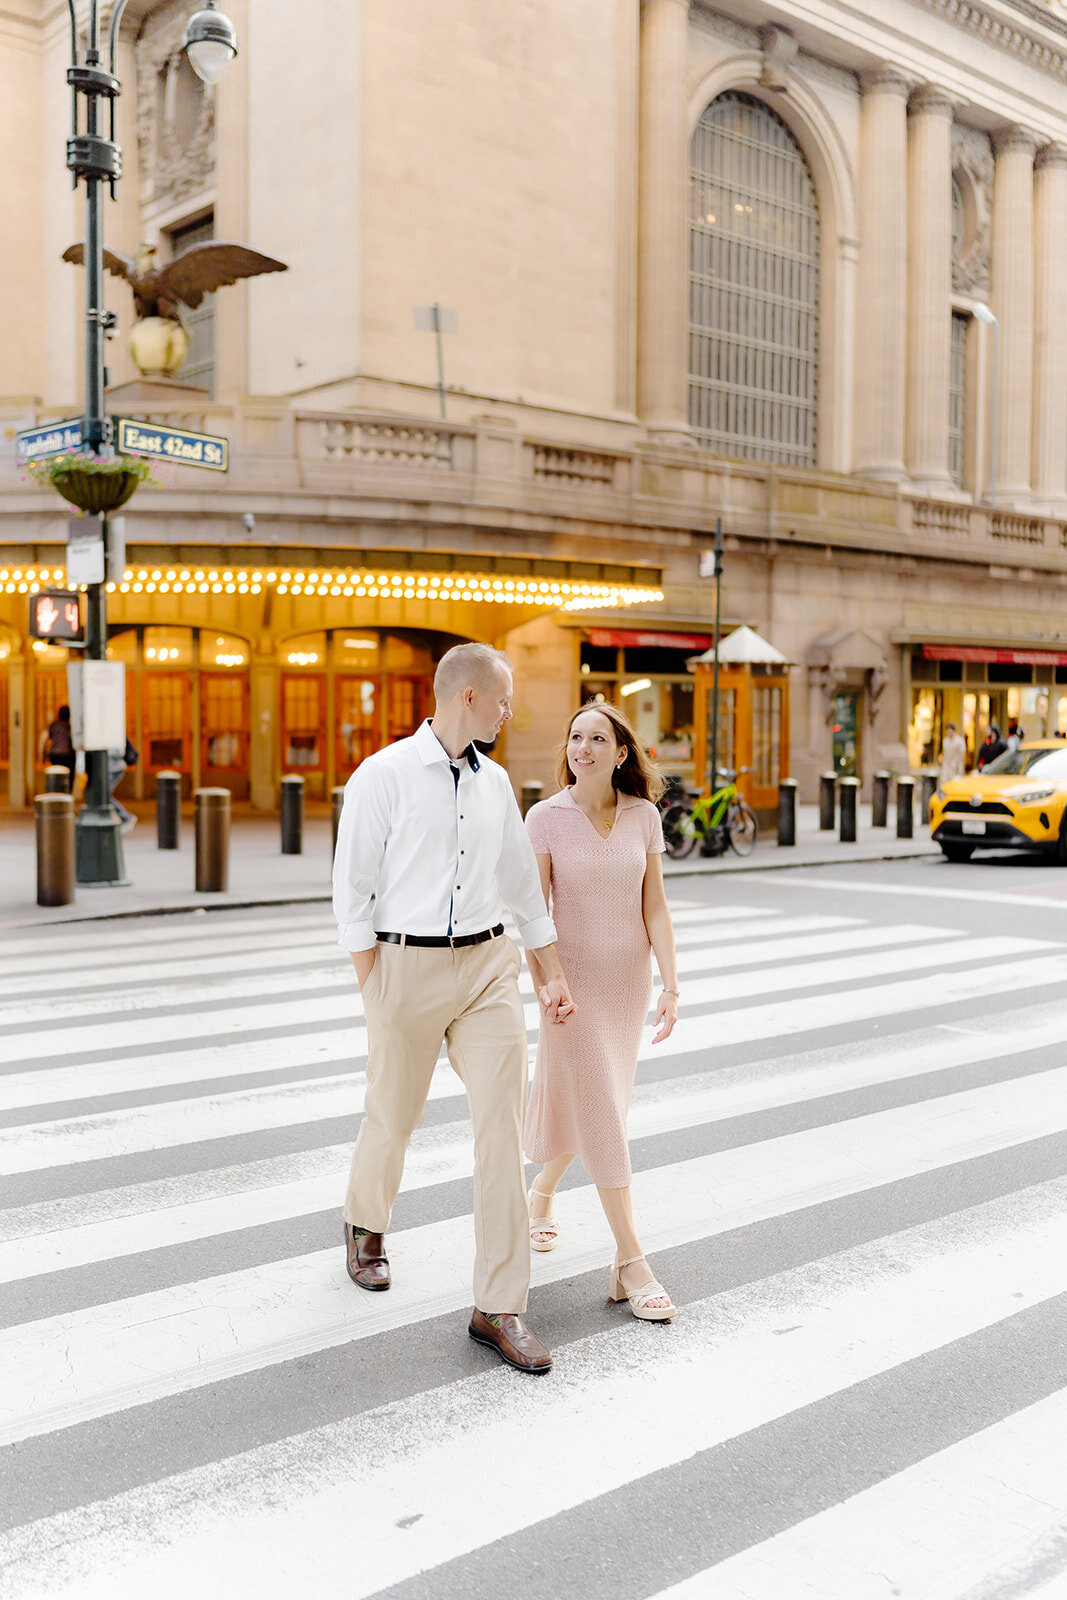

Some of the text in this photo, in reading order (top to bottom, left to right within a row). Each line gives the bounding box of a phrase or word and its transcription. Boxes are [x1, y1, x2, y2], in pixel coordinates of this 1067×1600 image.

[126, 428, 222, 463] East 42nd St
[65, 603, 79, 632] 4
